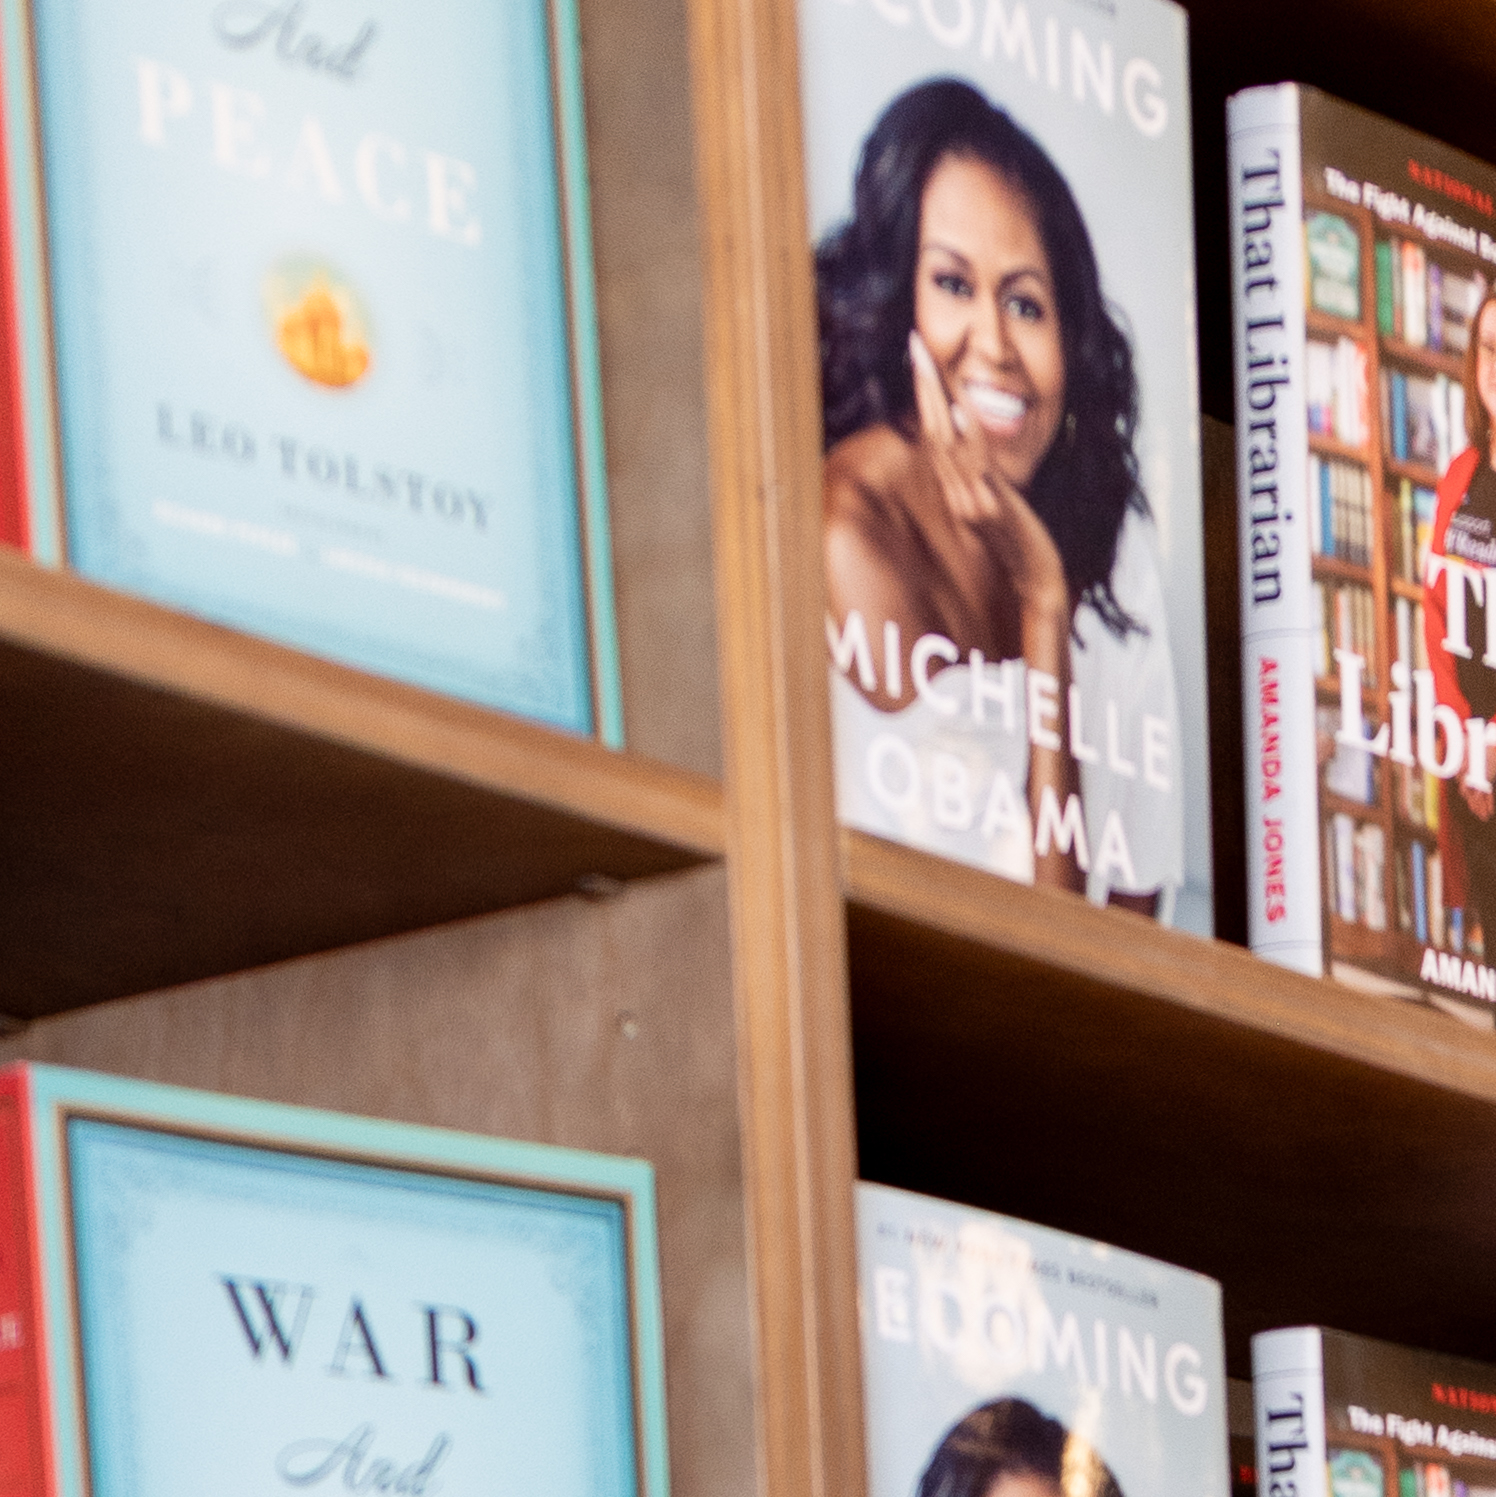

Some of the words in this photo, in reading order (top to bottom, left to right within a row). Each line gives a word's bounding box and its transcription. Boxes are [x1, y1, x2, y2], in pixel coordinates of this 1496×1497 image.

[131, 55, 485, 249] PEACE
[866, 735, 1137, 885] OBAMA
[212, 1272, 488, 1397] WAR
